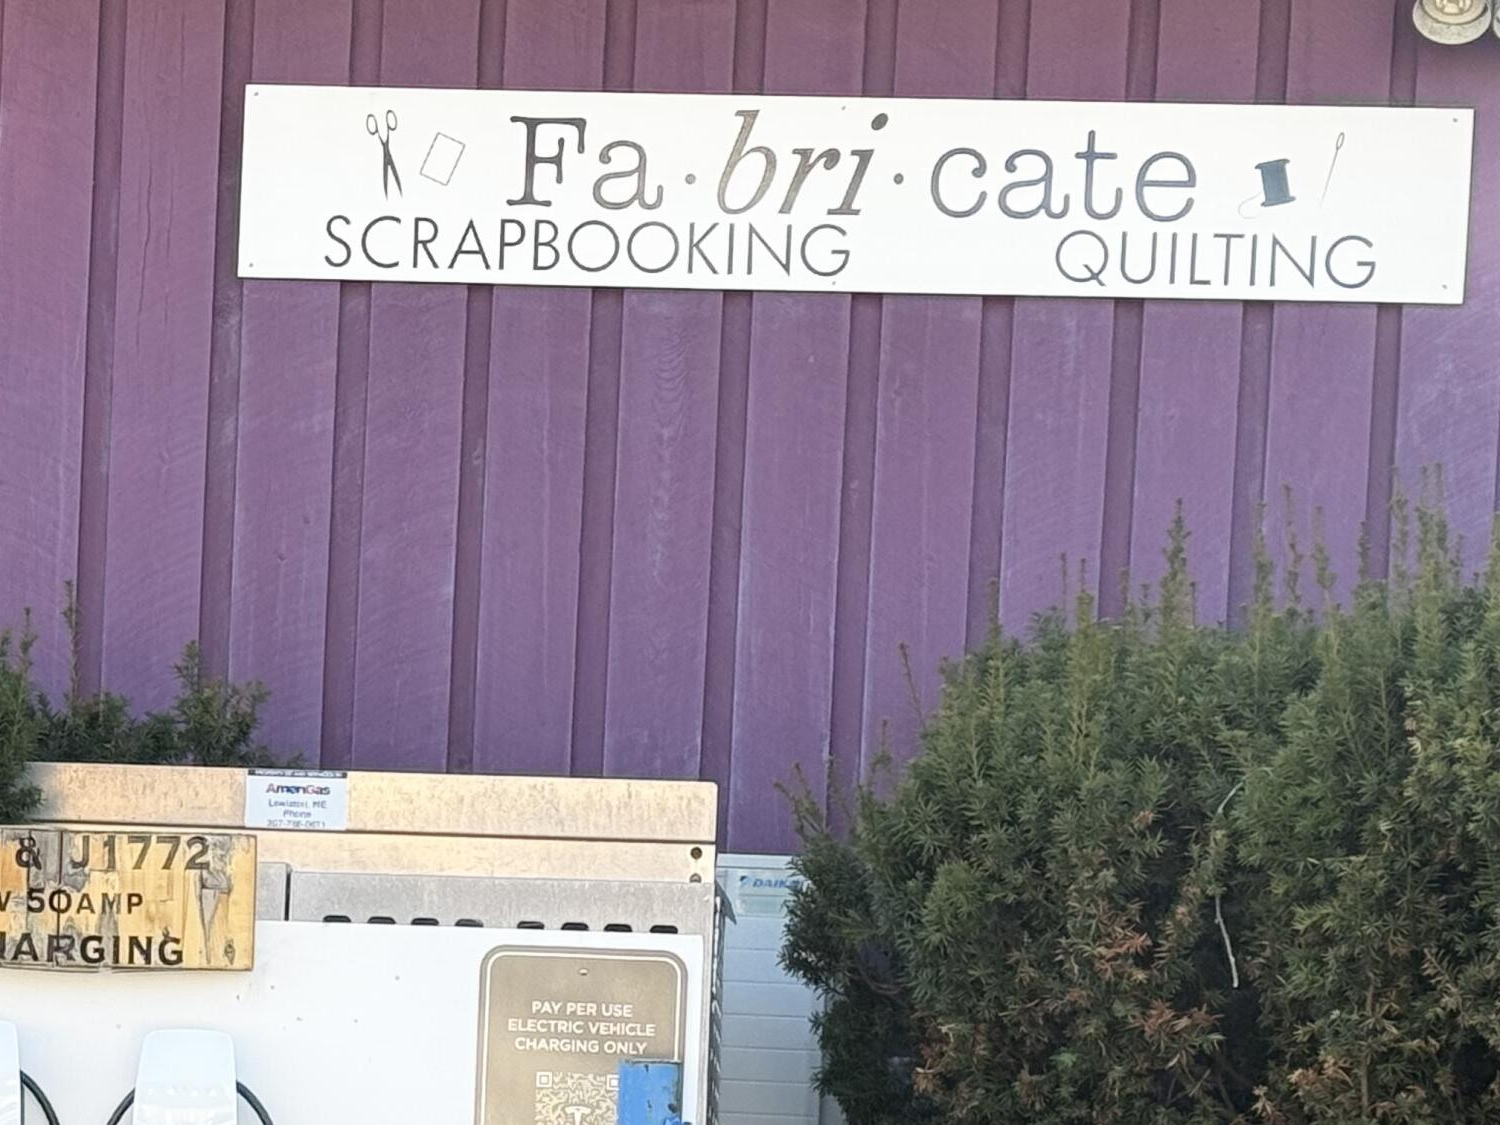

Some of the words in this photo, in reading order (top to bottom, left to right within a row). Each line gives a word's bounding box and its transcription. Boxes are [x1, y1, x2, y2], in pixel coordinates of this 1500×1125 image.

[324, 214, 852, 277] SCRAPBOOKING
[1054, 228, 1378, 291] QUILTING
[15, 837, 41, 870] &
[71, 836, 210, 870] J1772
[532, 1001, 563, 1015] PAY
[566, 1002, 597, 1016] PER
[601, 1003, 633, 1017] USE
[507, 1018, 584, 1034] ELECTRIC
[588, 1022, 657, 1037] VEHICLE
[515, 1037, 599, 1053] CHARGING
[603, 1041, 648, 1055] ONLY
